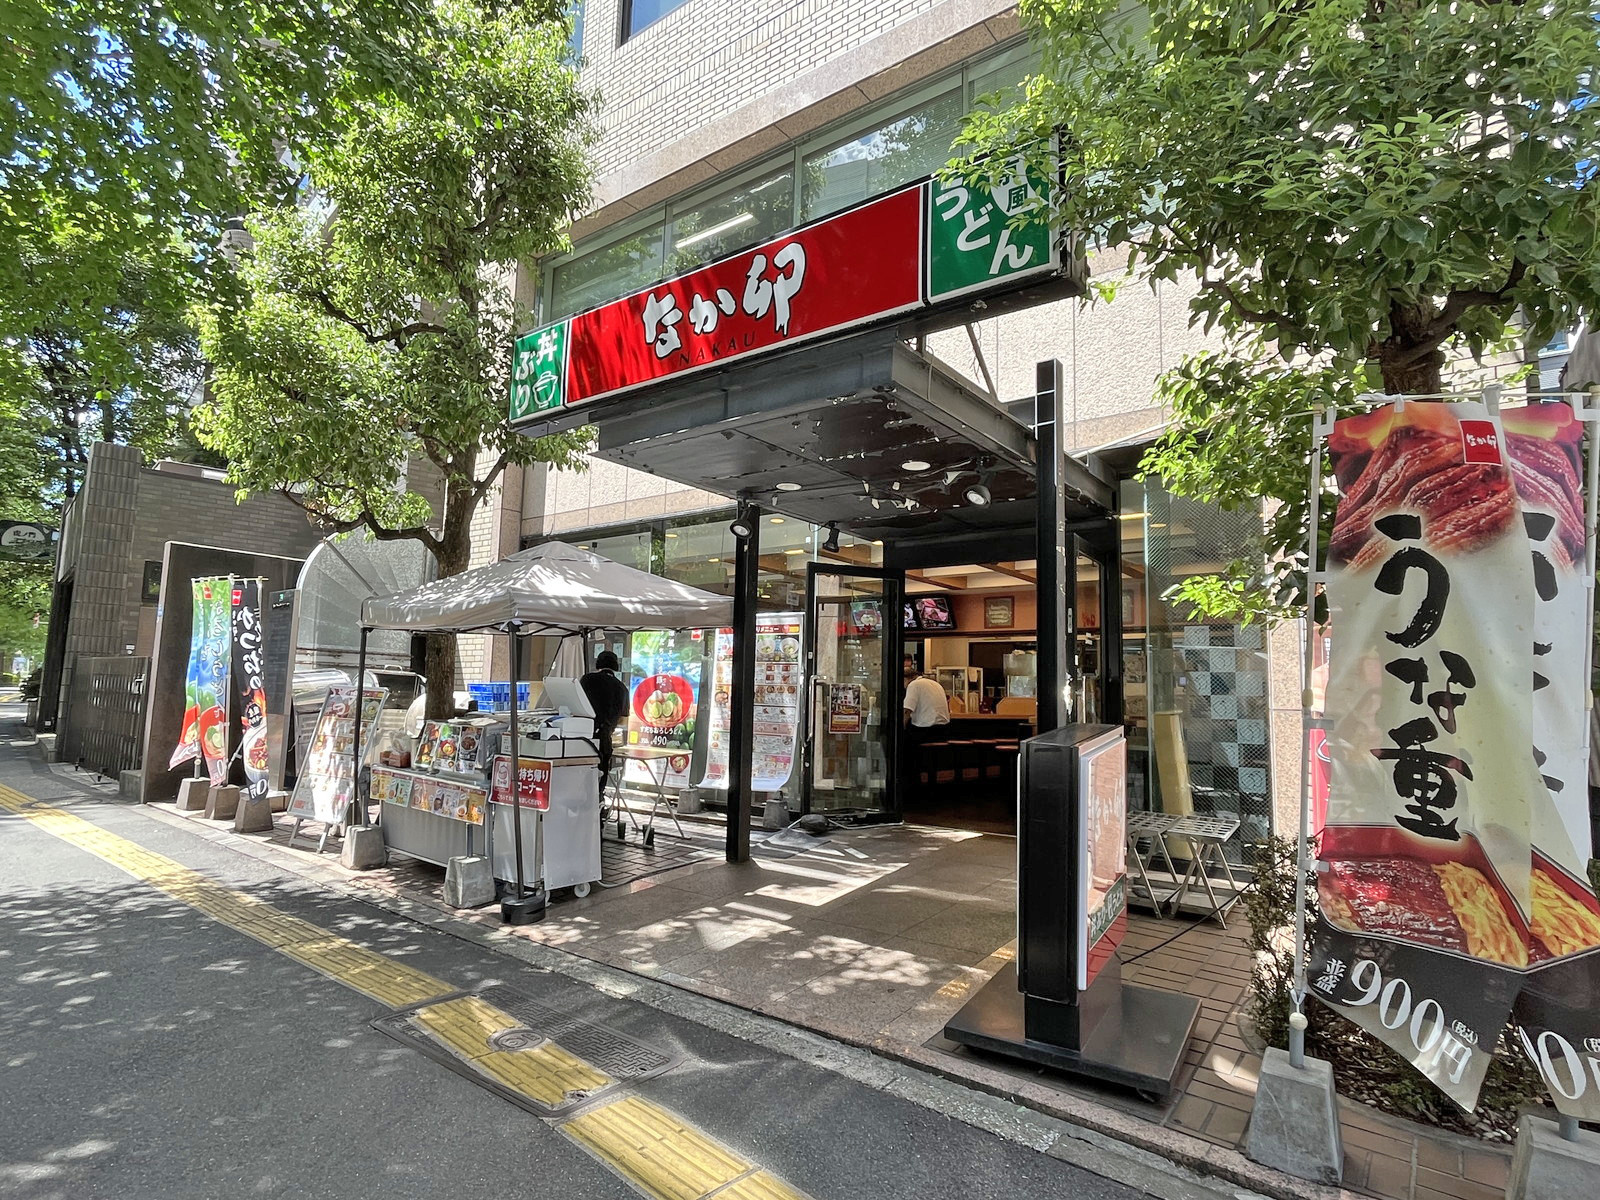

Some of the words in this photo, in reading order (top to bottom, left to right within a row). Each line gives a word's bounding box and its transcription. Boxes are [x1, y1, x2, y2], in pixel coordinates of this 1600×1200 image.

[935, 177, 1034, 275] うどん
[642, 242, 806, 359] なか卯
[515, 329, 558, 416] 丼ぶり
[679, 331, 756, 367] NAKAU
[1466, 433, 1497, 450] なか卯
[1371, 513, 1476, 842] うな重
[517, 767, 549, 783] 持ち帰り
[518, 781, 543, 794] コーナー
[1313, 957, 1347, 995] 並盛
[1342, 960, 1473, 1085] 900円
